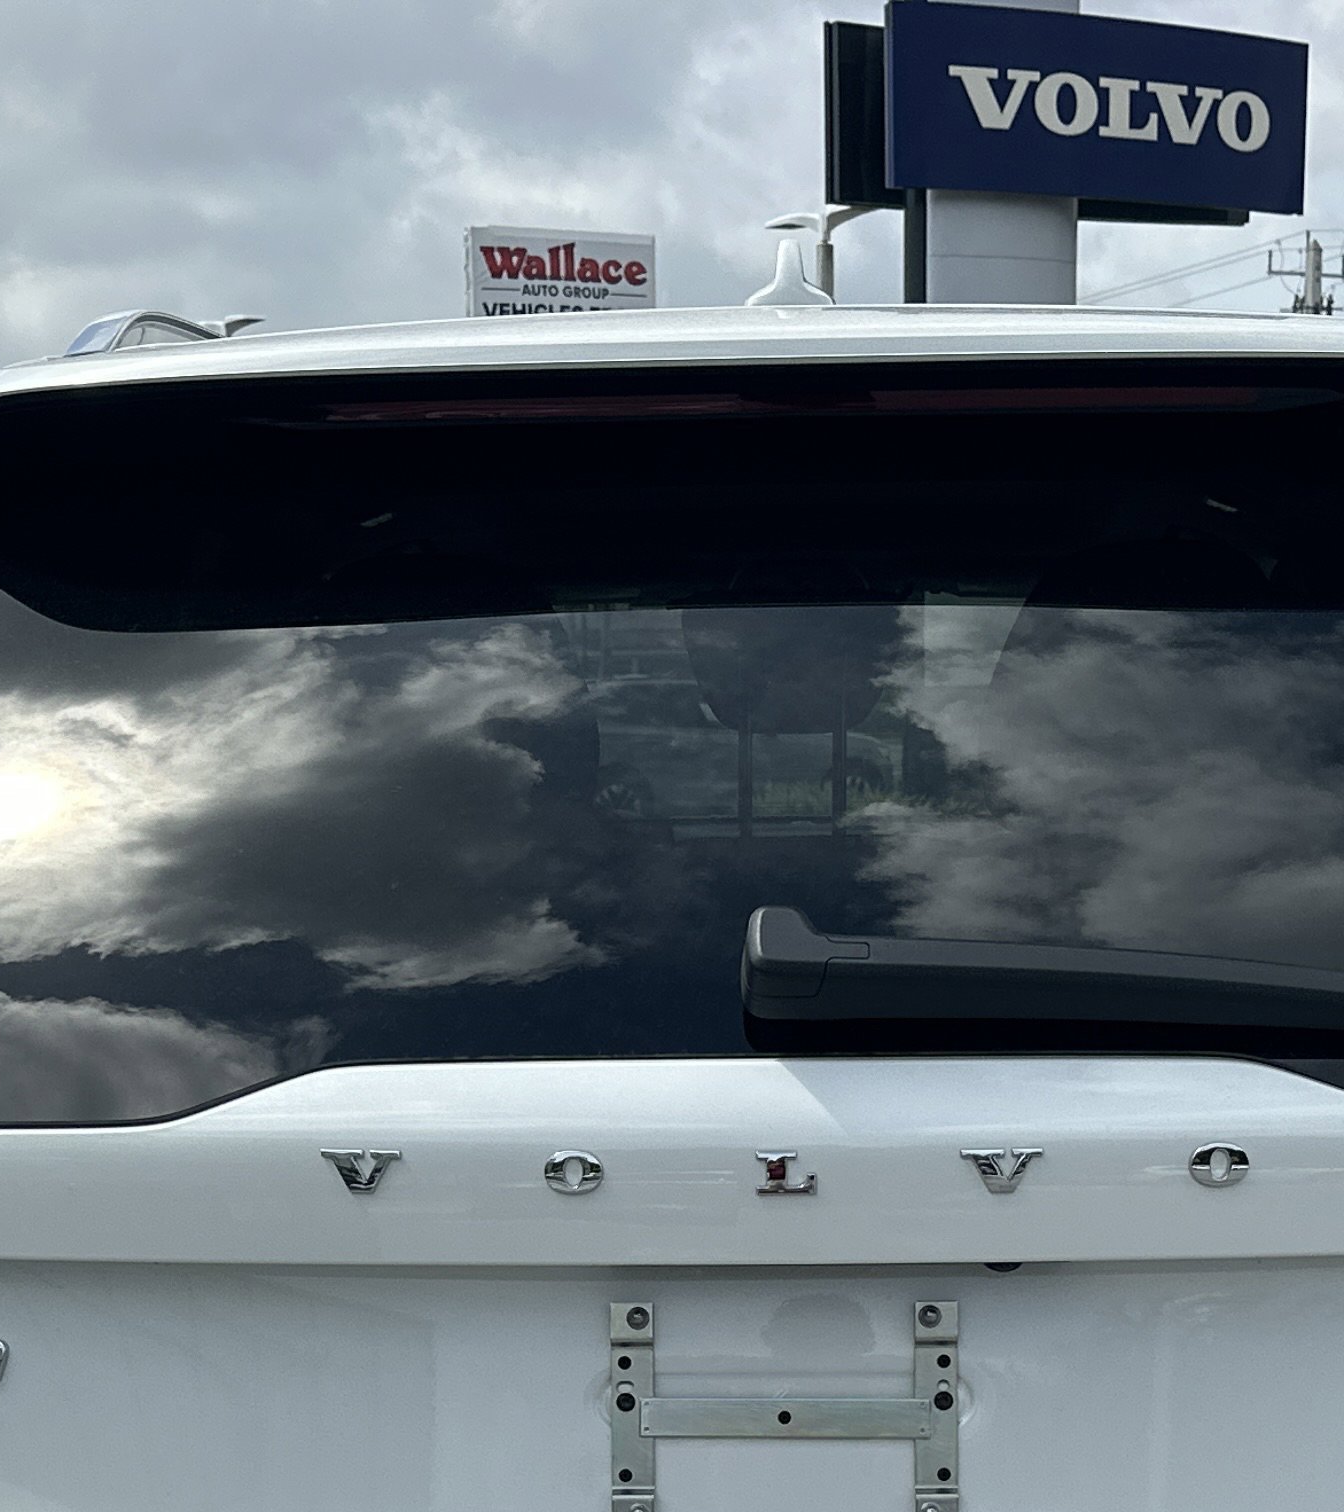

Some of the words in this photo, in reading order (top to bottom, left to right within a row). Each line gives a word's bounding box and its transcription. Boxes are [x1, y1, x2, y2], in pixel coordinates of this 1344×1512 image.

[948, 64, 1270, 153] VOLVO
[480, 242, 648, 286] Wallace
[521, 284, 559, 297] AUTO
[562, 286, 610, 300] GROUP
[319, 1142, 1251, 1196] VOLVO
